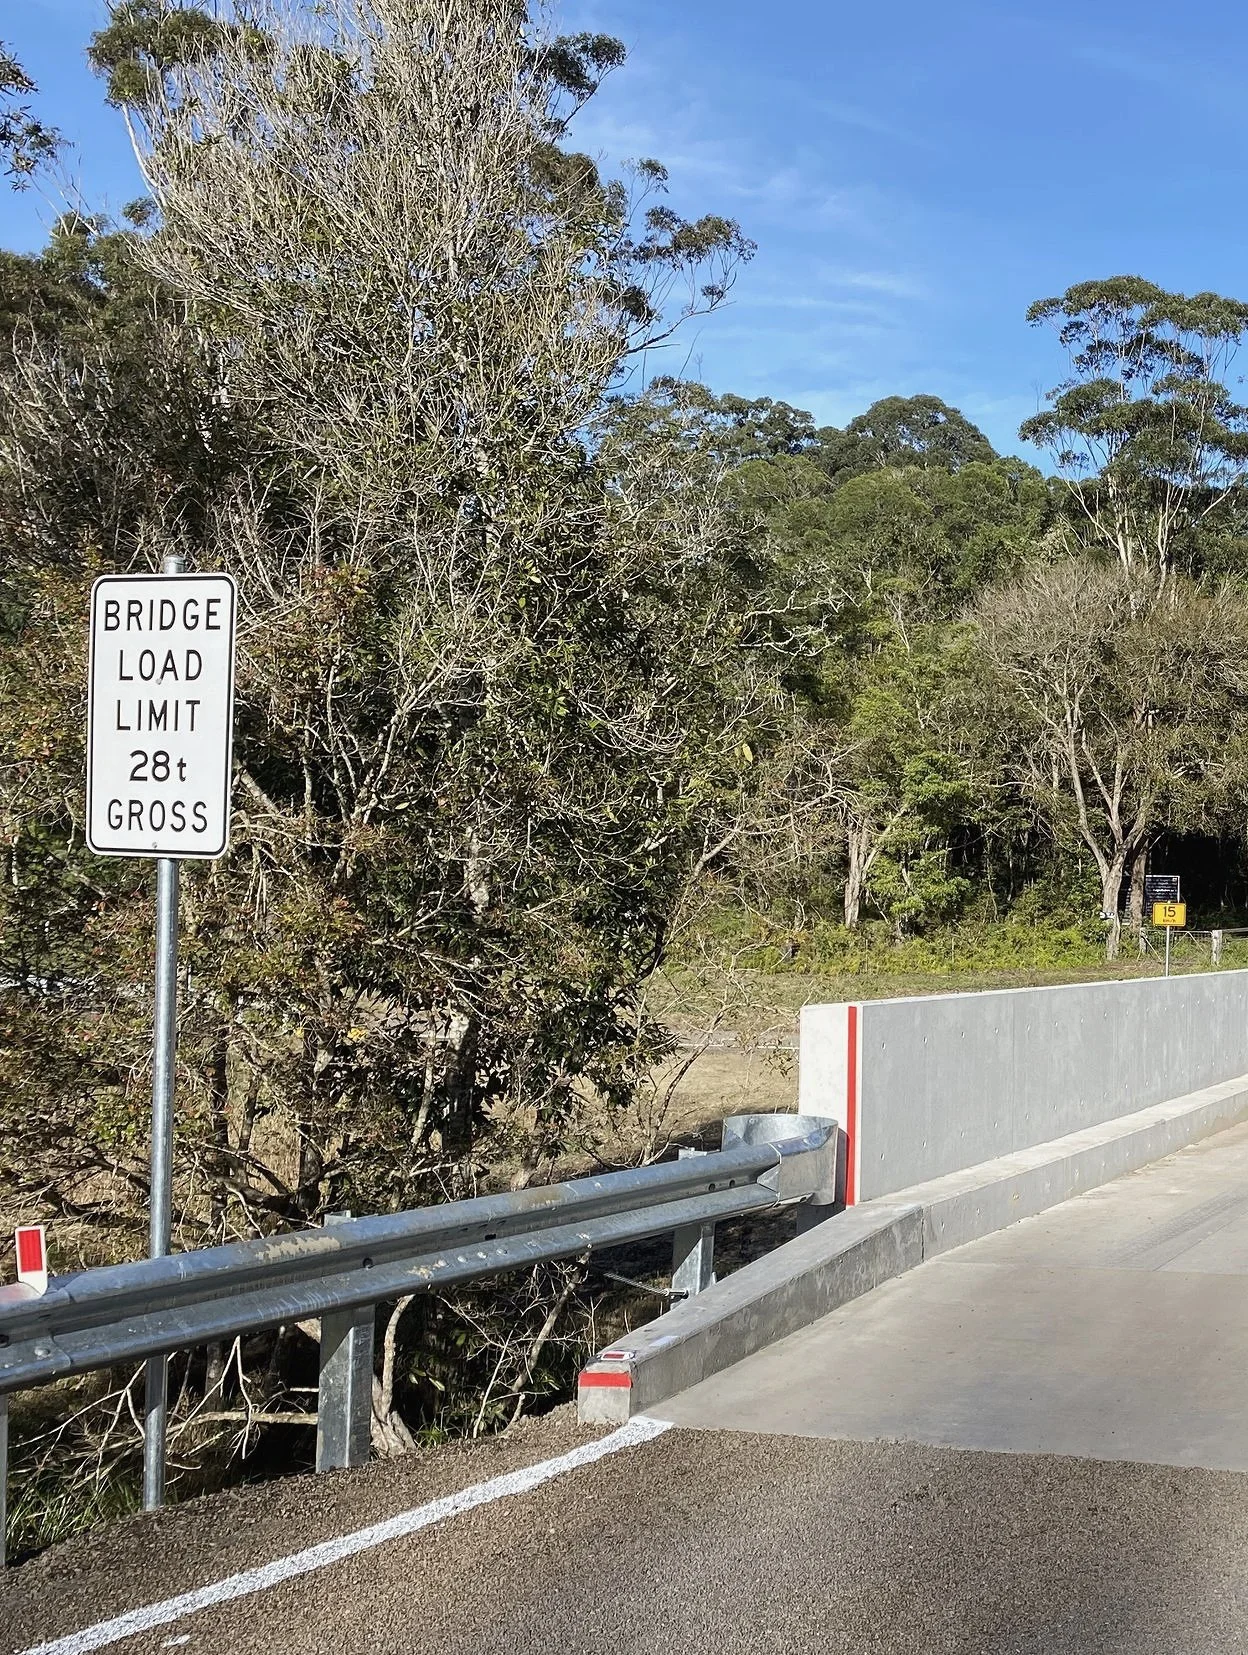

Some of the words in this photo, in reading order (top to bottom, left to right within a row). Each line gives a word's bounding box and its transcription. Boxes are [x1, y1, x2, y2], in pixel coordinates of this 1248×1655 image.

[104, 598, 221, 631] BRIDGE
[118, 649, 203, 681] LOAD
[116, 699, 201, 732] LIMIT
[107, 798, 208, 833] GROSS
[1163, 906, 1176, 918] 15
